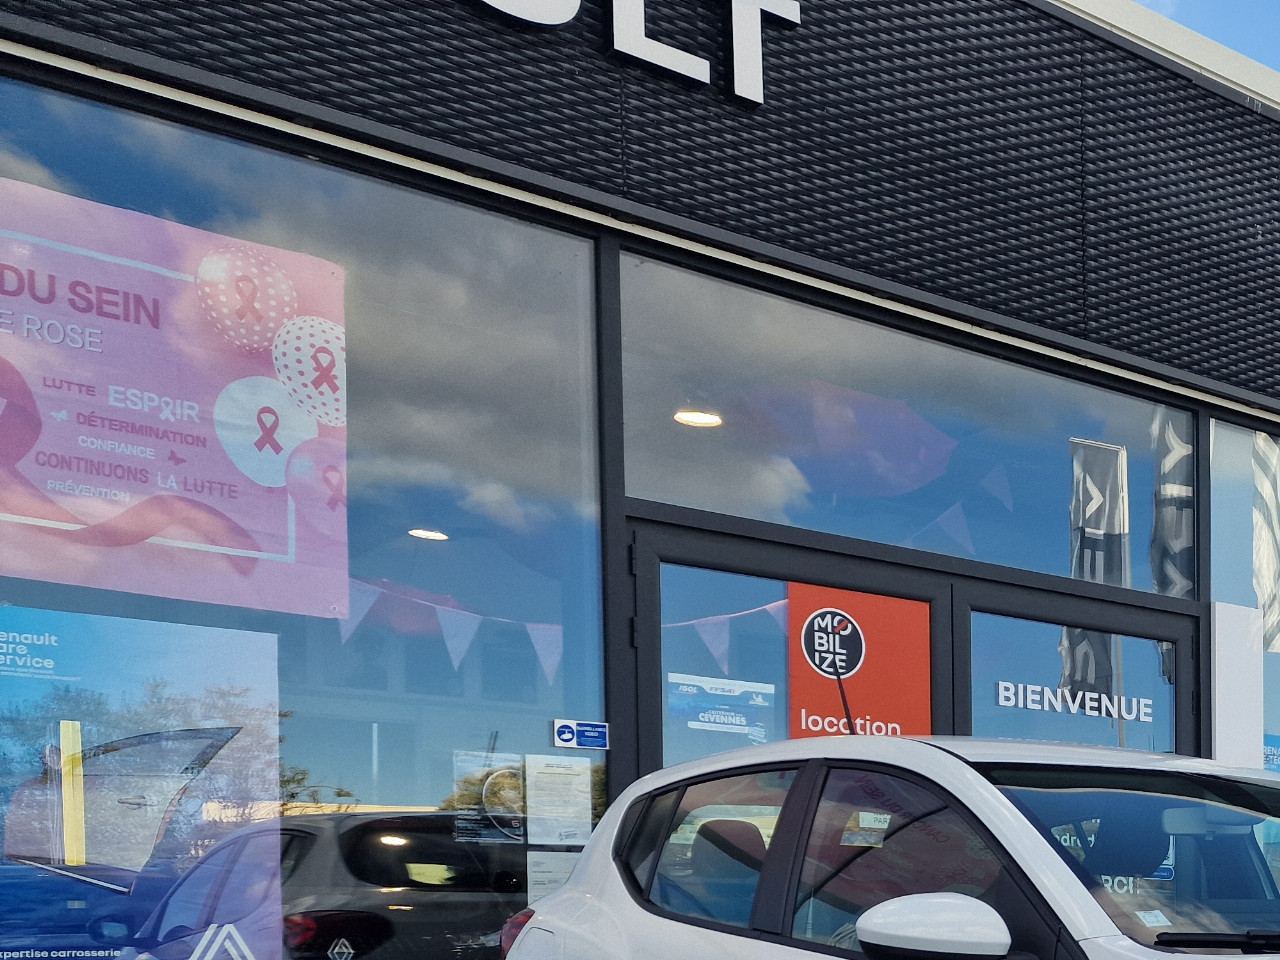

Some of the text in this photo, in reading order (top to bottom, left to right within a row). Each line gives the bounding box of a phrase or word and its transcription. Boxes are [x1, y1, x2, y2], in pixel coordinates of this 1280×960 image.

[0, 262, 160, 329] DU SEIN
[22, 314, 103, 353] ROSE
[42, 376, 96, 397] LUTTE
[76, 411, 207, 448] DÉTERMINATION
[78, 436, 155, 459] CONFIANCE
[35, 450, 238, 499] CONTINUONS LA LUTTE
[47, 480, 130, 502] PRÉVENTION
[998, 680, 1153, 723] BIENVENUE
[801, 708, 901, 735] location
[0, 949, 121, 959] pertise carrosserie
